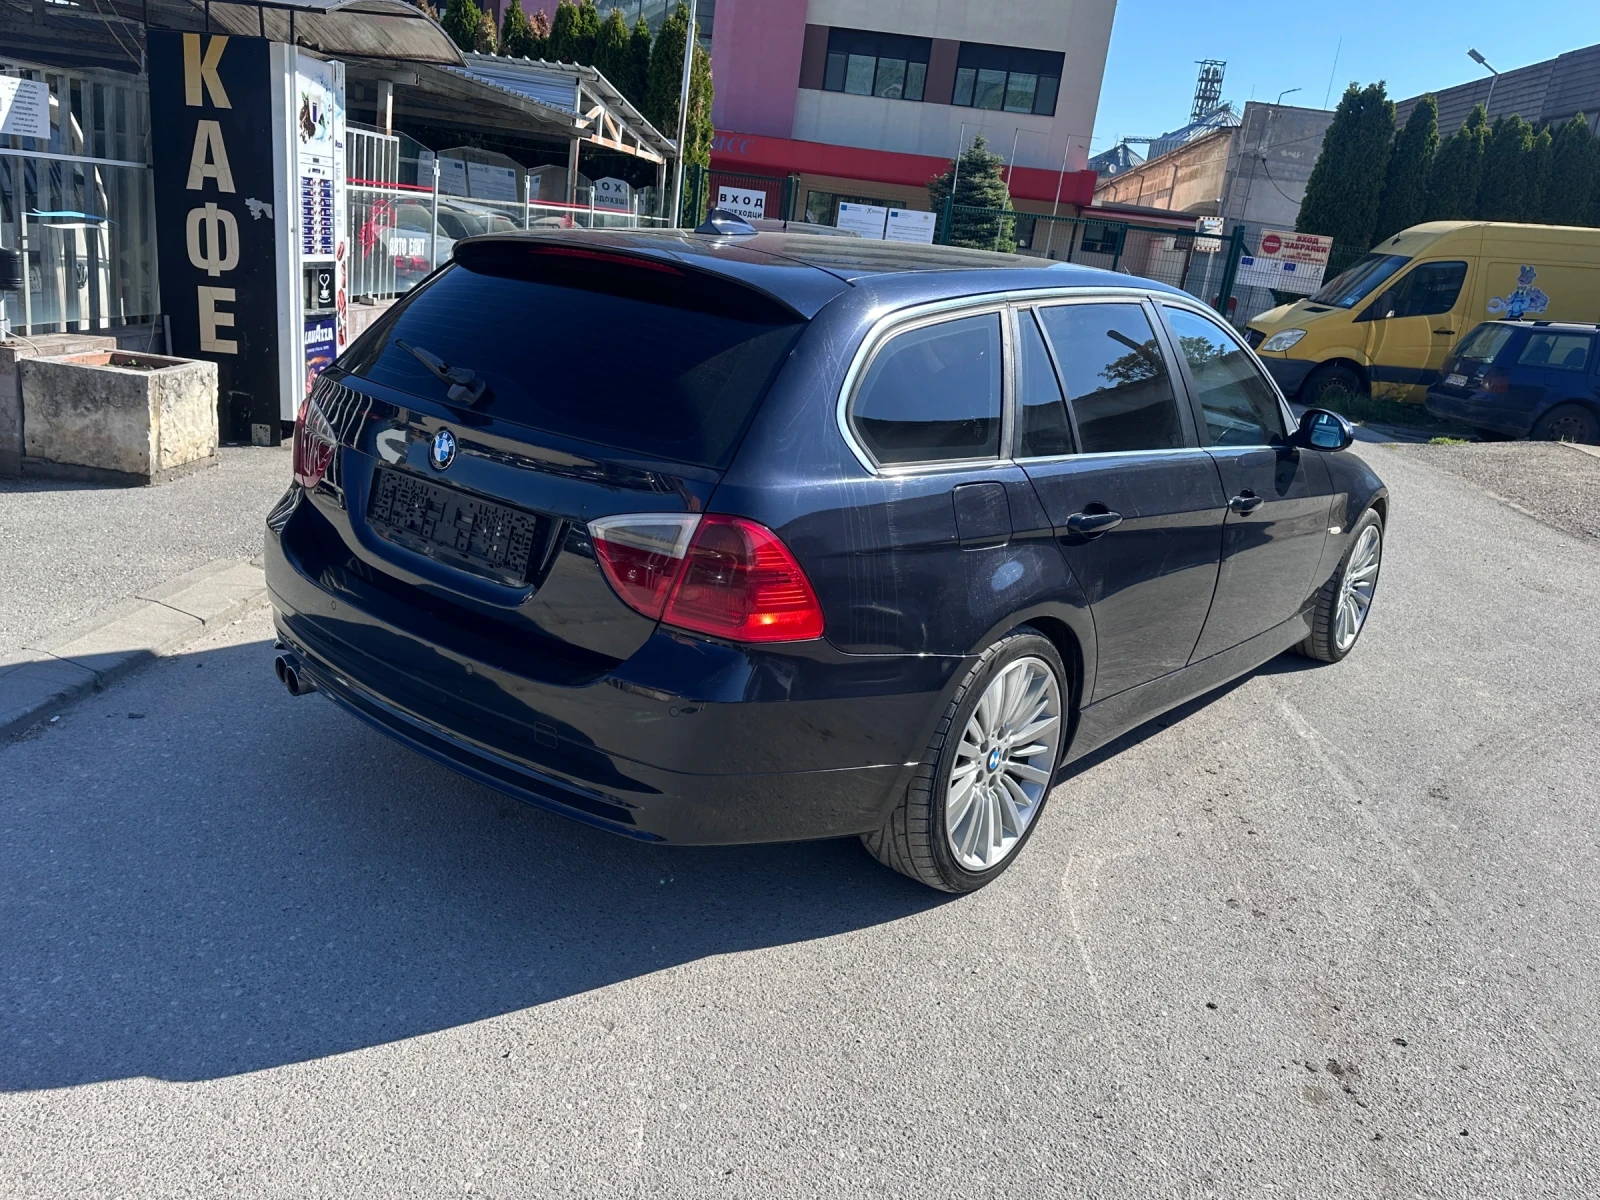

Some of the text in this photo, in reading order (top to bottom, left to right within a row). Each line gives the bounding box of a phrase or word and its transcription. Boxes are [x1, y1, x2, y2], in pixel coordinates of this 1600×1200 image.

[183, 32, 240, 354] КАФЕ
[719, 193, 763, 209] ВХОД
[721, 207, 762, 219] ШЕХОДЦИ
[1284, 242, 1327, 253] ЗАБРАНЕН
[1295, 235, 1319, 246] ВХОД
[304, 324, 334, 345] LAVAZZA
